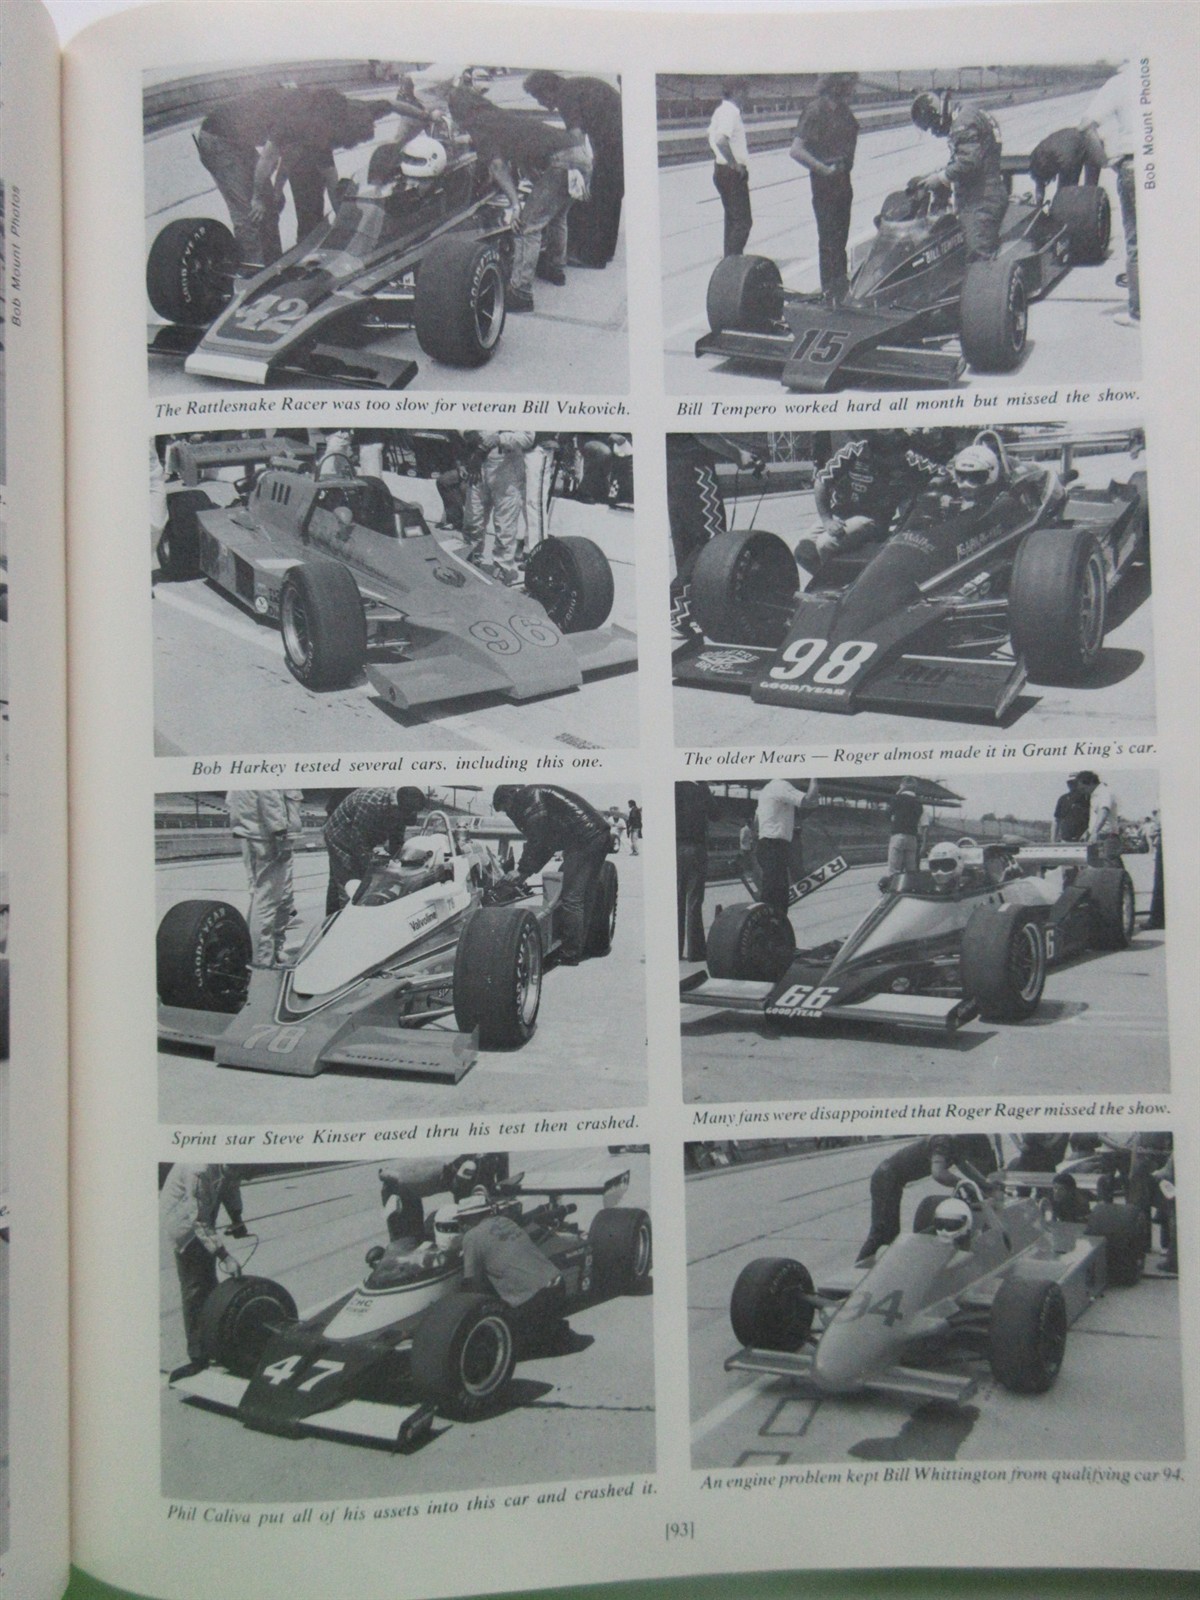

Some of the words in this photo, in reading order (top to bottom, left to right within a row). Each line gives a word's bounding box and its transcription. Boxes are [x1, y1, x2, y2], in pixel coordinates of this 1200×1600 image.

[1140, 57, 1151, 105] Photos
[1142, 111, 1154, 156] Mount
[1144, 162, 1156, 190] Bob
[11, 186, 21, 238] Photos
[11, 243, 21, 290] Mount
[12, 298, 22, 327] Bob
[235, 294, 310, 334] 42
[790, 328, 852, 365] 15
[155, 403, 181, 418] The
[186, 397, 277, 415] Rattlesnake
[281, 396, 329, 411] Racer
[333, 400, 361, 410] was
[366, 399, 391, 410] too
[395, 397, 429, 412] slow
[431, 397, 457, 415] for
[461, 400, 517, 414] veteran
[521, 400, 550, 415] Bill
[556, 400, 630, 416] Vukovich.
[677, 401, 704, 416] Bill
[711, 401, 777, 418] Tempero
[784, 399, 839, 413] worked
[846, 398, 882, 412] hard
[890, 396, 909, 411] all
[916, 394, 965, 410] month
[972, 393, 998, 408] but
[1006, 390, 1059, 406] missed
[1066, 388, 1091, 403] the
[1097, 387, 1141, 402] show.
[469, 614, 560, 655] 96
[769, 638, 878, 685] 98
[760, 681, 847, 696] GOODYEAR
[192, 760, 222, 775] Bob
[230, 759, 287, 776] Harkey
[295, 758, 341, 772] tested
[349, 757, 404, 772] several
[456, 756, 528, 773] including
[537, 754, 565, 769] this
[572, 758, 603, 769] one.
[684, 752, 712, 765] The
[717, 750, 755, 764] older
[760, 750, 806, 764] Mears
[833, 748, 880, 765] Roger
[884, 746, 934, 761] almost
[940, 744, 981, 759] made
[986, 745, 996, 758] it
[1002, 744, 1017, 758] in
[1022, 742, 1067, 758] Grant
[1129, 744, 1157, 755] car.
[409, 908, 438, 932] Valvoline
[766, 1006, 823, 1018] GOODYEAR
[775, 984, 840, 1009] 66
[242, 1023, 307, 1054] 78
[693, 1110, 737, 1127] Many
[735, 1109, 770, 1126] fans
[773, 1109, 807, 1121] were
[810, 1105, 908, 1123] disappointed
[911, 1104, 941, 1118] that
[945, 1104, 992, 1120] Roger
[994, 1103, 1042, 1120] Rager
[1044, 1101, 1096, 1116] missed
[1100, 1101, 1125, 1115] the
[1128, 1100, 1172, 1115] show.
[172, 1130, 216, 1148] Sprint
[225, 1132, 255, 1146] star
[262, 1131, 304, 1145] Steve
[312, 1129, 366, 1144] Kinser
[374, 1125, 418, 1142] eased
[426, 1124, 460, 1138] thru
[468, 1122, 491, 1137] his
[499, 1122, 525, 1136] test
[534, 1118, 568, 1133] then
[576, 1115, 639, 1132] crashed.
[263, 1355, 346, 1392] 47
[699, 1475, 721, 1490] An
[726, 1473, 777, 1491] engine
[778, 1470, 842, 1489] problem
[847, 1468, 880, 1485] kept
[883, 1467, 910, 1482] Bill
[914, 1466, 1007, 1485] Whittington
[1008, 1466, 1047, 1485] from
[1051, 1466, 1131, 1486] qualifying
[1134, 1471, 1160, 1482] car
[1162, 1467, 1185, 1482] 94.
[167, 1504, 198, 1520] Phil
[203, 1507, 251, 1523] Caliva
[256, 1511, 285, 1528] put
[292, 1507, 313, 1523] all
[320, 1506, 339, 1525] of
[343, 1505, 366, 1520] his
[373, 1503, 420, 1519] assets
[427, 1500, 459, 1515] into
[467, 1495, 496, 1511] this
[504, 1495, 531, 1508] car
[537, 1487, 567, 1505] and
[575, 1481, 636, 1501] crashed
[641, 1480, 658, 1495] it.
[665, 1521, 695, 1541] [93]
